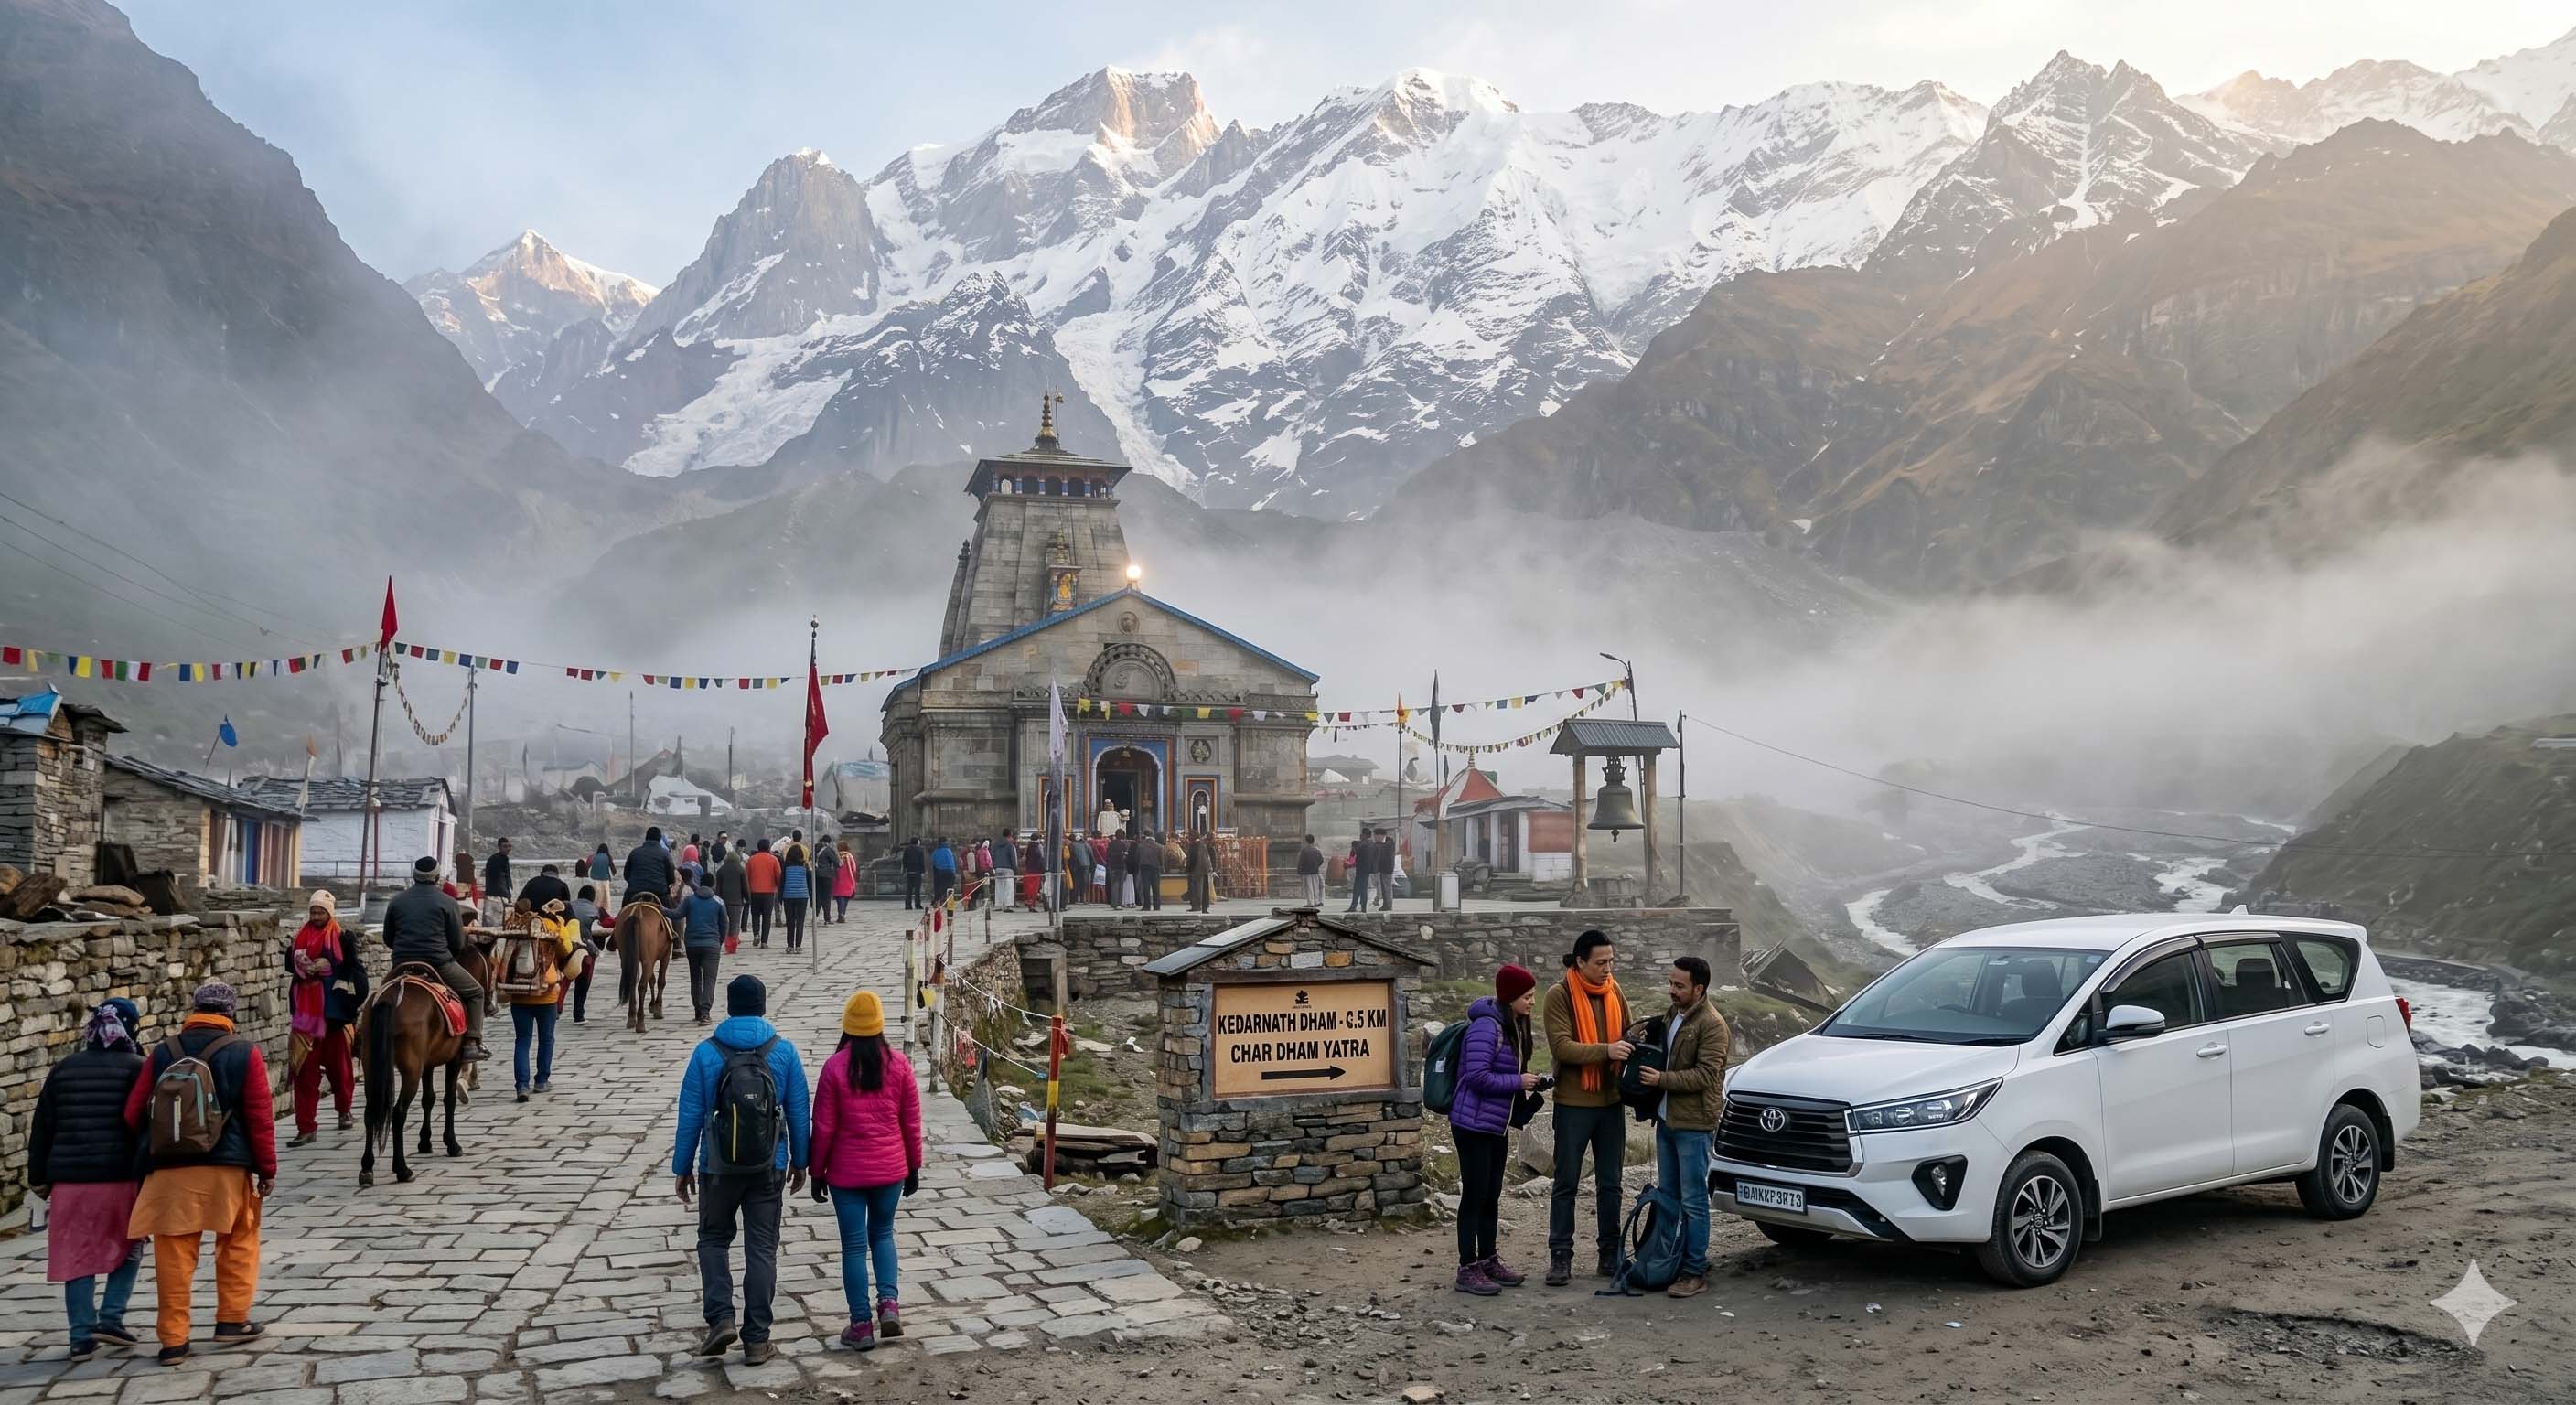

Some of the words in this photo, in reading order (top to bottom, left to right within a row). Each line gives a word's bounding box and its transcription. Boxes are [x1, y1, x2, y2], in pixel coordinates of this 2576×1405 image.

[1218, 1013, 1296, 1035] KEDARNATH
[1300, 1011, 1336, 1031] DHAM
[1368, 1008, 1387, 1028] KM
[1231, 1043, 1272, 1063] CHAR
[1276, 1041, 1318, 1061] DHAM
[1323, 1038, 1370, 1059] YATRA
